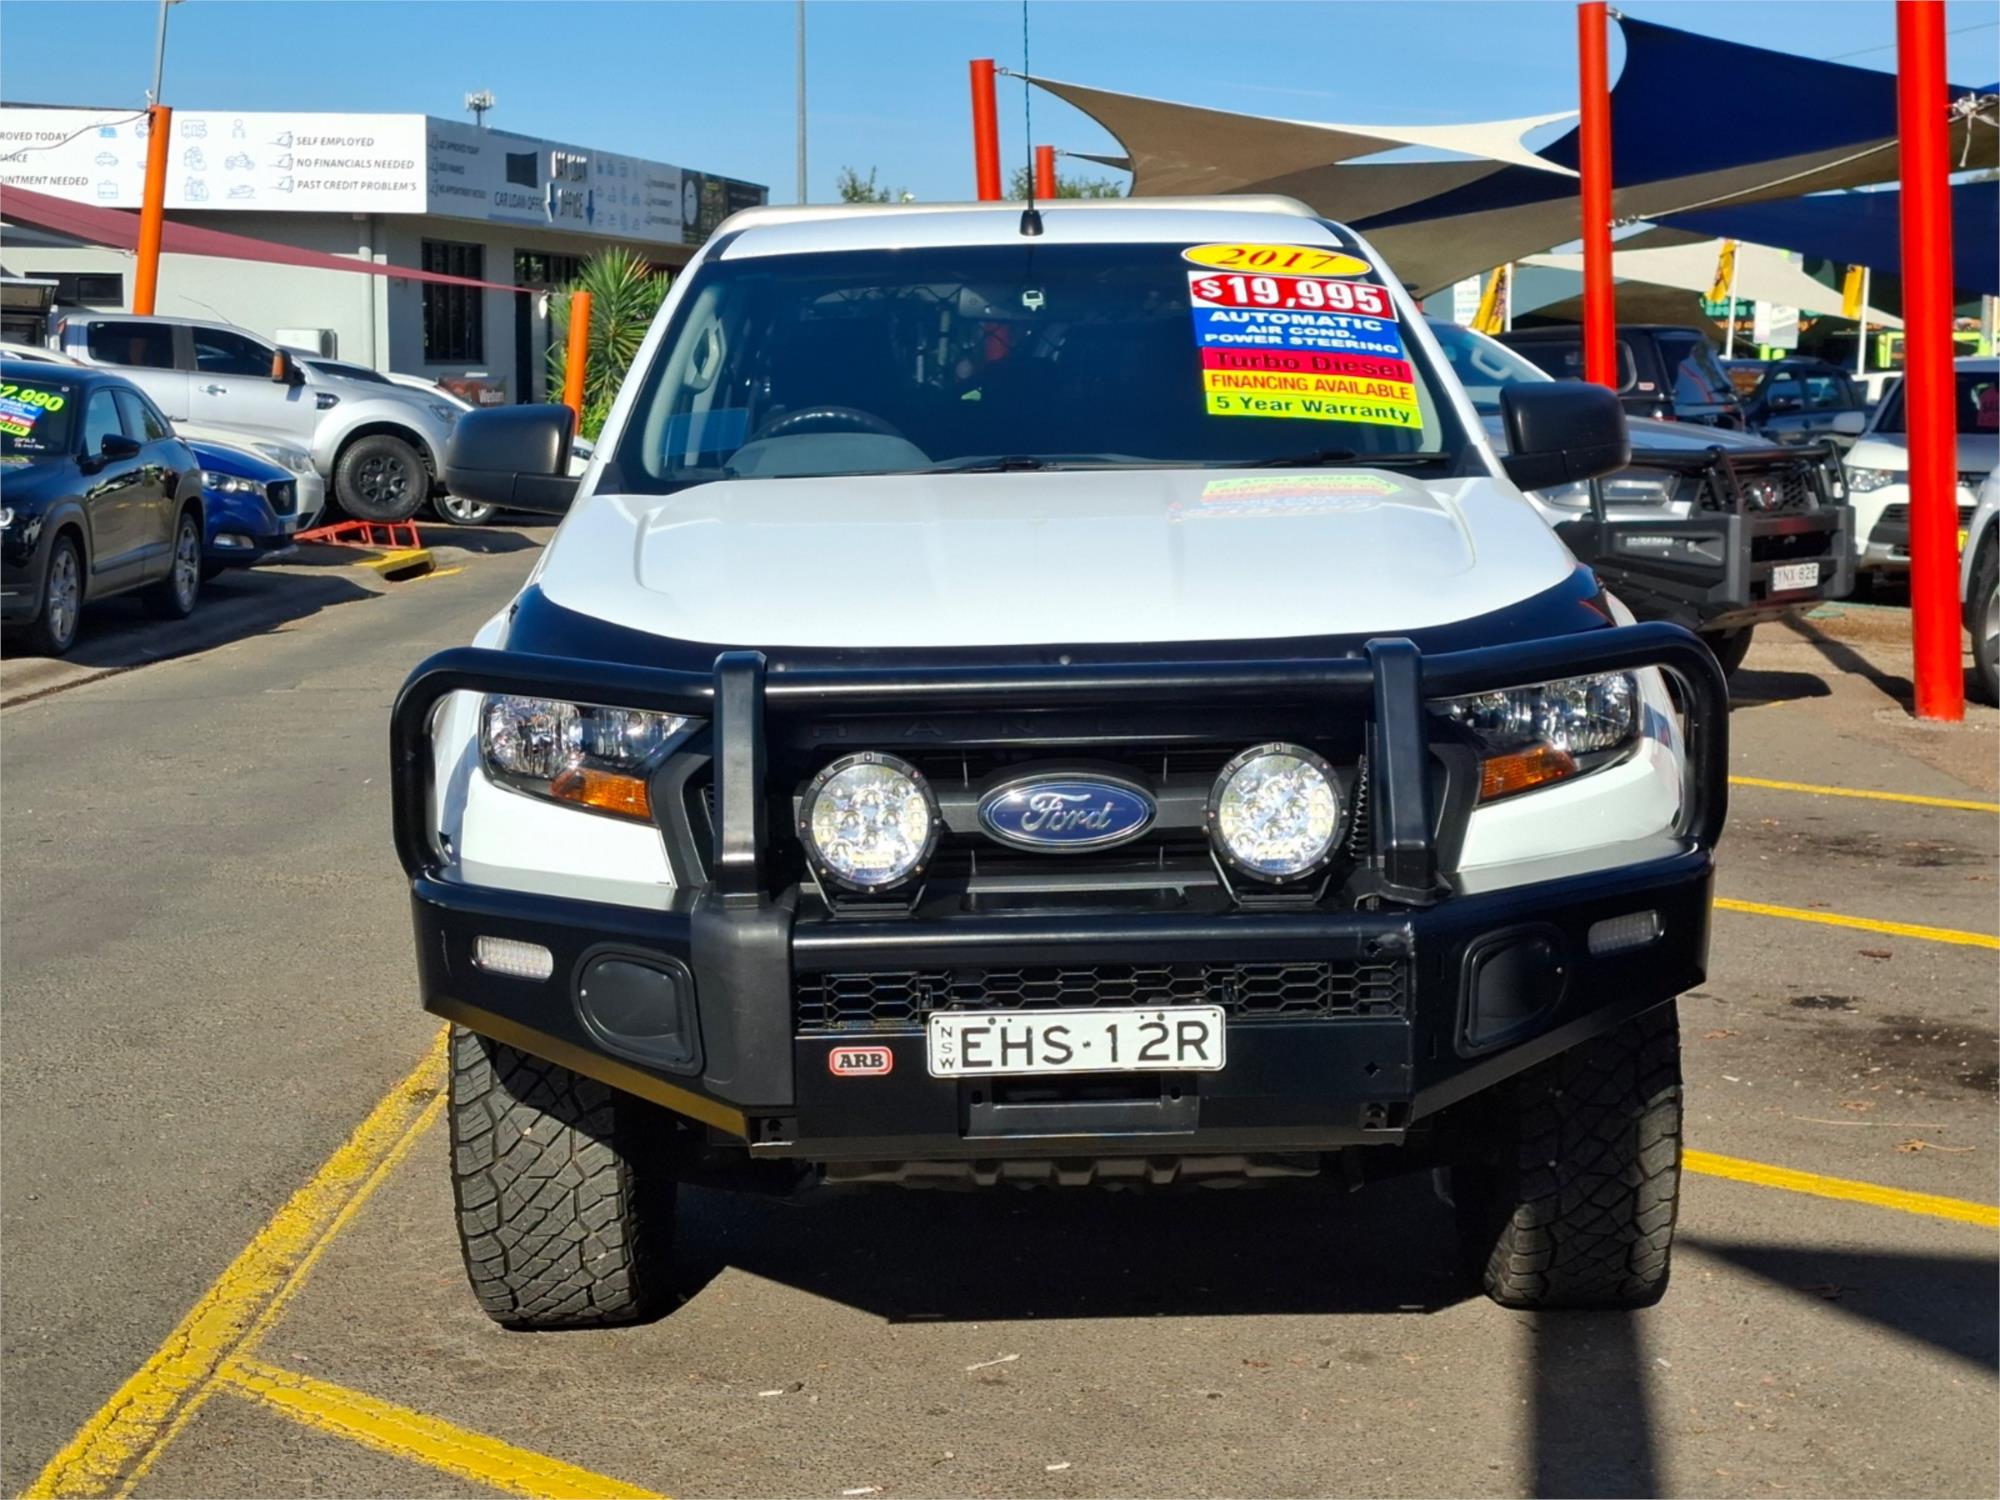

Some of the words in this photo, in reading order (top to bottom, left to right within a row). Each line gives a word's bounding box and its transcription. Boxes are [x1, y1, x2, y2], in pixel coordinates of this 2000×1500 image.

[35, 132, 68, 141] TODAY
[296, 136, 318, 146] SELF
[320, 136, 375, 147] EMPLOYED
[296, 158, 312, 168] NO
[314, 159, 372, 169] FINANCIALS
[373, 159, 415, 170] NEEDED
[50, 176, 89, 186] NEEDED
[297, 180, 321, 190] PAST
[323, 181, 358, 190] CREDIT
[360, 181, 417, 192] PROBLEM'S
[1215, 247, 1337, 270] 2017
[1199, 275, 1384, 314] $19,995
[1209, 310, 1384, 332] AUTOMATIC
[1245, 325, 1283, 335] AIR
[1289, 326, 1356, 340] COND.
[1204, 333, 1283, 345] POWER
[1290, 335, 1399, 354] STEERING
[1215, 351, 1300, 371] Turbo
[1312, 356, 1405, 379] Diesel
[1211, 374, 1309, 392] FINANCING
[1314, 379, 1412, 401] AVAILABLE
[1216, 395, 1230, 410] 5
[1239, 396, 1293, 412] Year
[1302, 399, 1411, 424] Warranty
[1020, 791, 1115, 832] Ford
[838, 1053, 885, 1069] ARB
